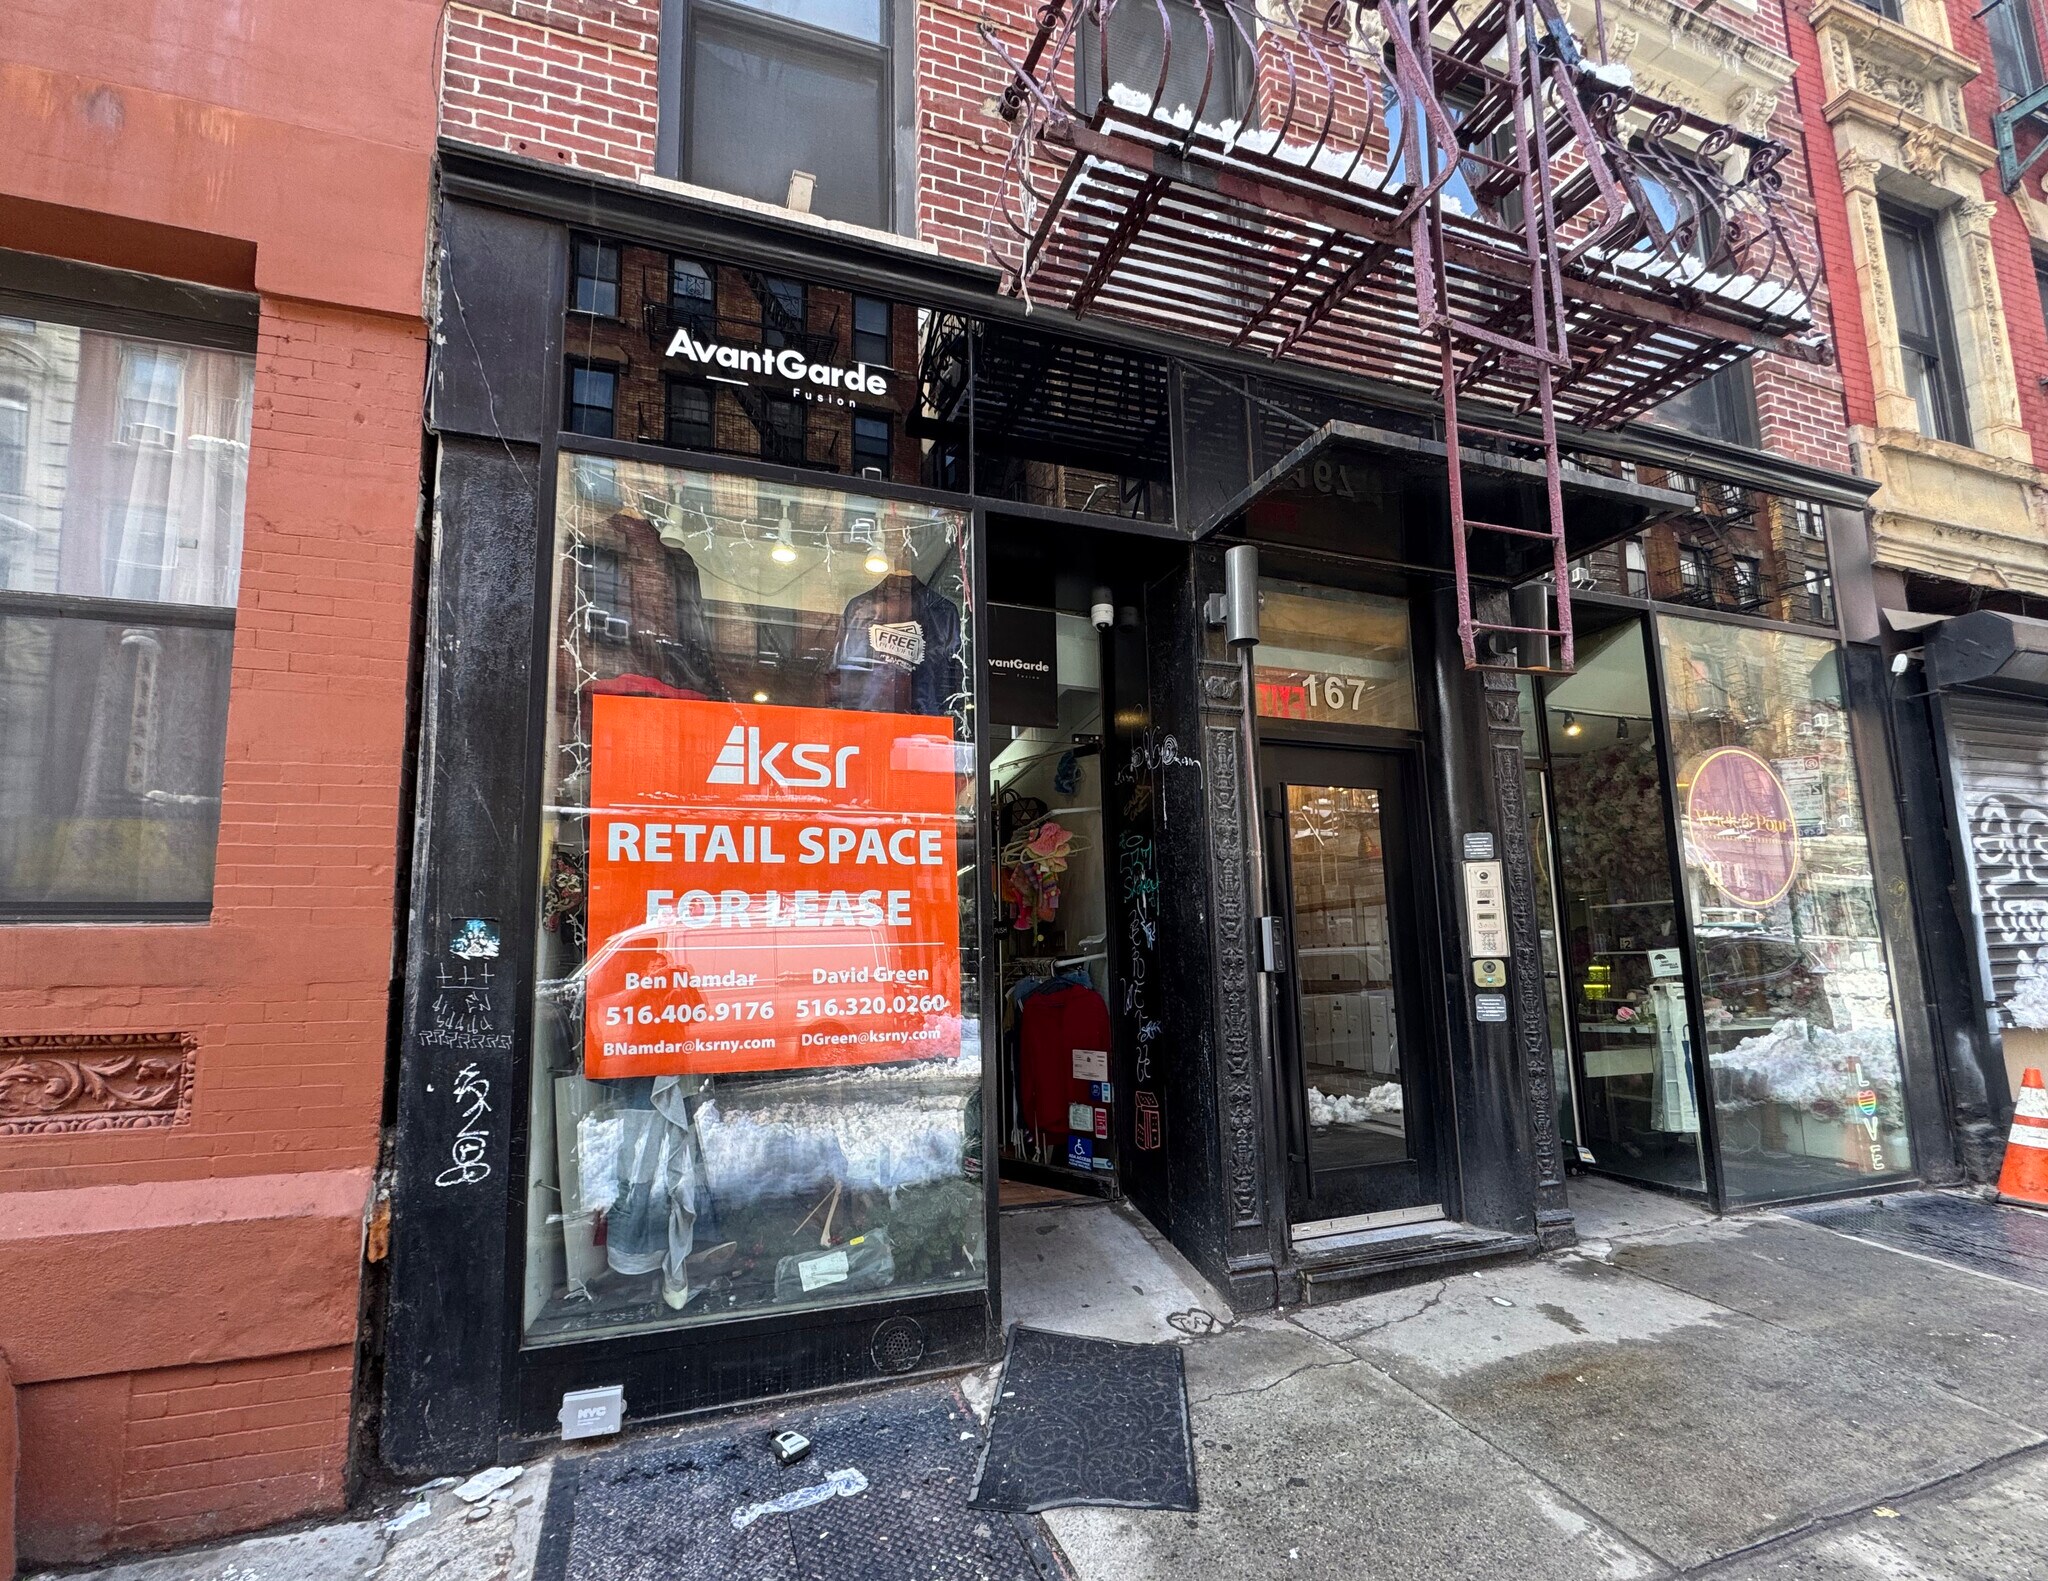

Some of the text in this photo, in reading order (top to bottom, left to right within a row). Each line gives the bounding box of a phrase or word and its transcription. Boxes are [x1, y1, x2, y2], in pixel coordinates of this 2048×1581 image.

[665, 328, 887, 396] AvantGarde
[793, 388, 856, 408] Fusion
[879, 631, 917, 650] FREE
[988, 658, 1049, 672] vantGarde
[1302, 674, 1367, 711] 167
[608, 822, 943, 865] RETAIL SPACE
[646, 889, 912, 929] FOR LEASE
[625, 969, 757, 990] Ben Namdar
[812, 966, 929, 985] David Green
[605, 1001, 775, 1026] 516.406.9176
[795, 994, 946, 1018] 516.320.0260
[603, 1035, 776, 1057] BNamdar@ksrny.com
[801, 1028, 941, 1047] DGreen@ksrny.com
[577, 1405, 607, 1419] NYC
